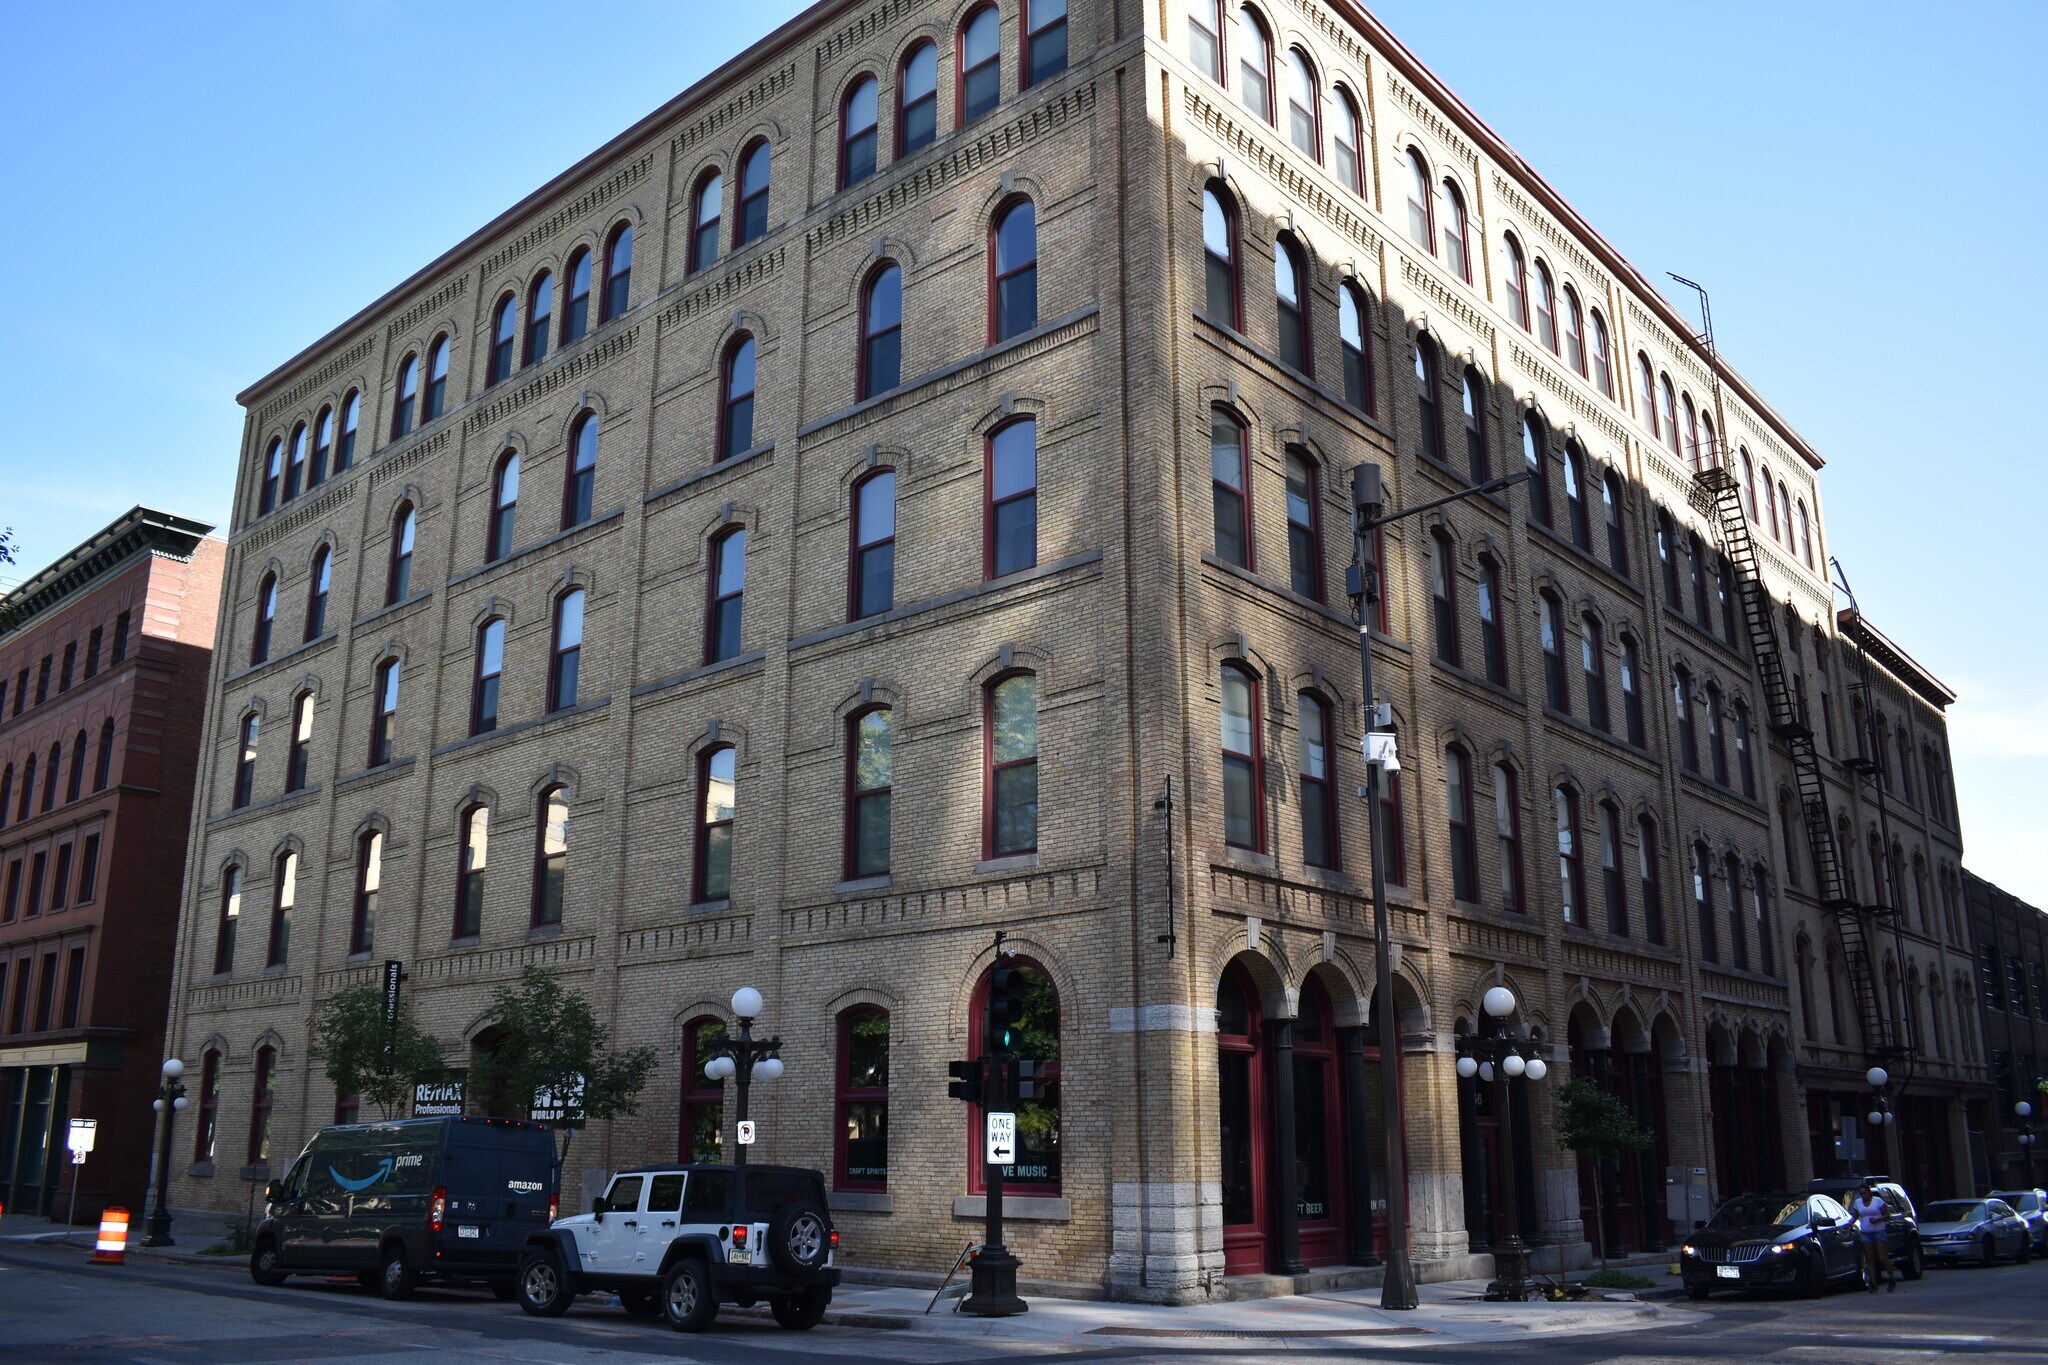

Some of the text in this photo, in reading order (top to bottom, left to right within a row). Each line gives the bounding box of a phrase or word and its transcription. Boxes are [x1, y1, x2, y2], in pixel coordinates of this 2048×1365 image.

[416, 1083, 462, 1101] RE/MAX
[415, 1103, 461, 1115] Professionals
[531, 1110, 555, 1120] WORLD
[992, 1118, 1011, 1129] ONE
[991, 1132, 1011, 1142] WAY
[394, 1151, 423, 1171] prime
[1002, 1165, 1048, 1177] VE MUSIC
[508, 1180, 543, 1191] amazon
[1306, 1203, 1323, 1214] BEER
